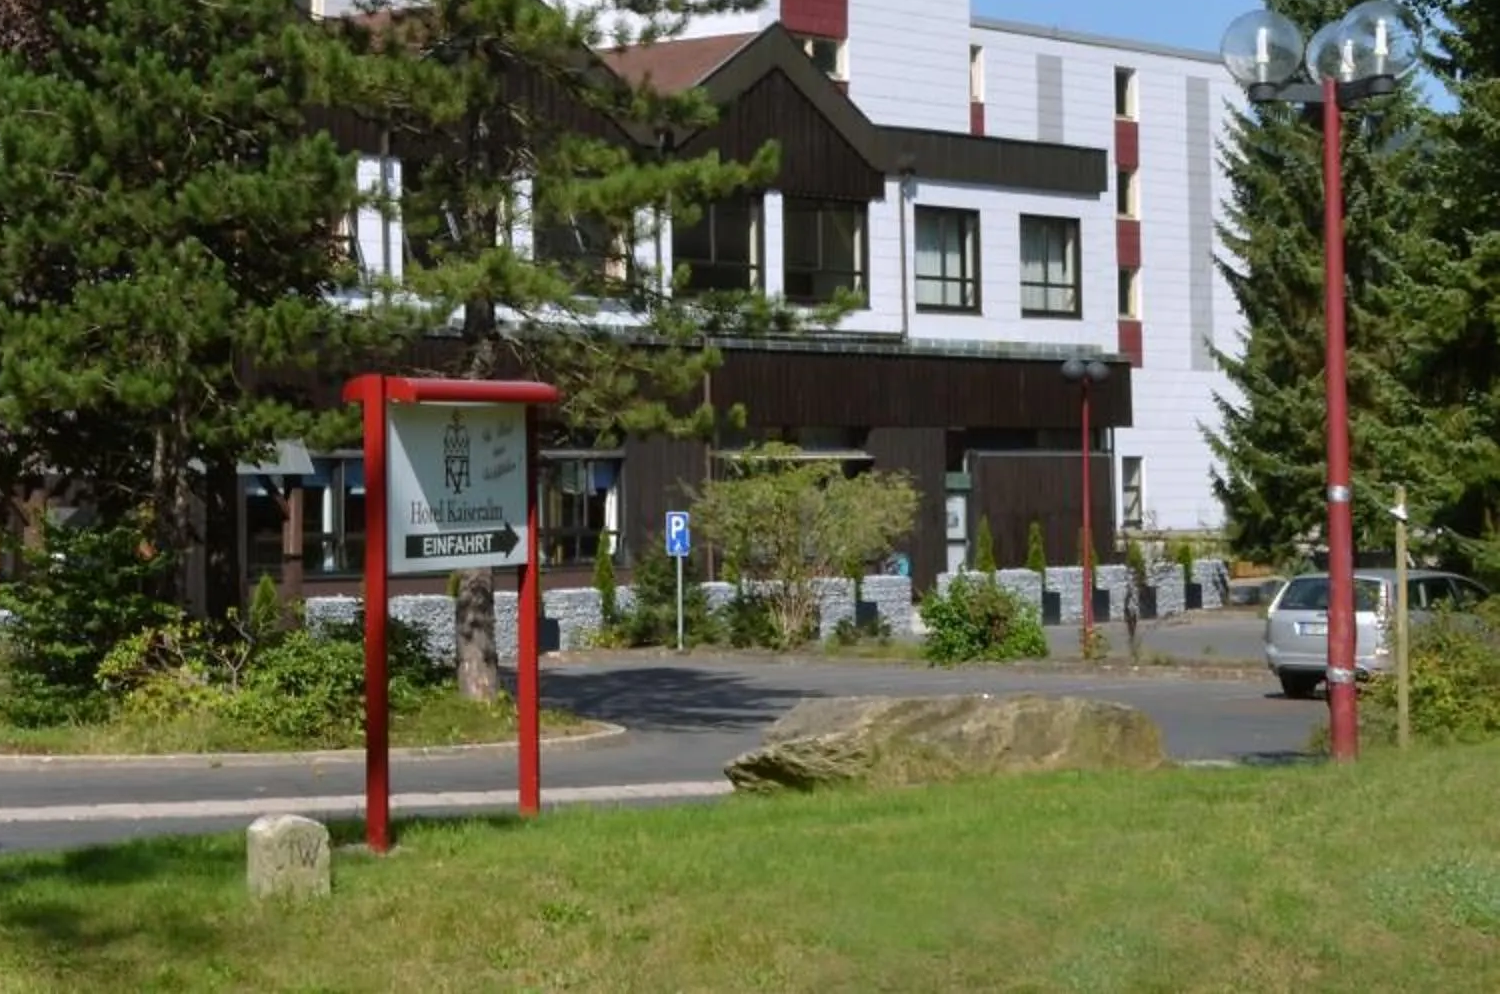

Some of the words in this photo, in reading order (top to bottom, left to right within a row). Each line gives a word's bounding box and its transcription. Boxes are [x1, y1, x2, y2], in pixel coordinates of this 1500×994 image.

[411, 498, 443, 525] Hotel
[447, 496, 503, 523] Kaiseralm
[671, 516, 685, 539] P
[423, 533, 494, 556] EINFAHRT
